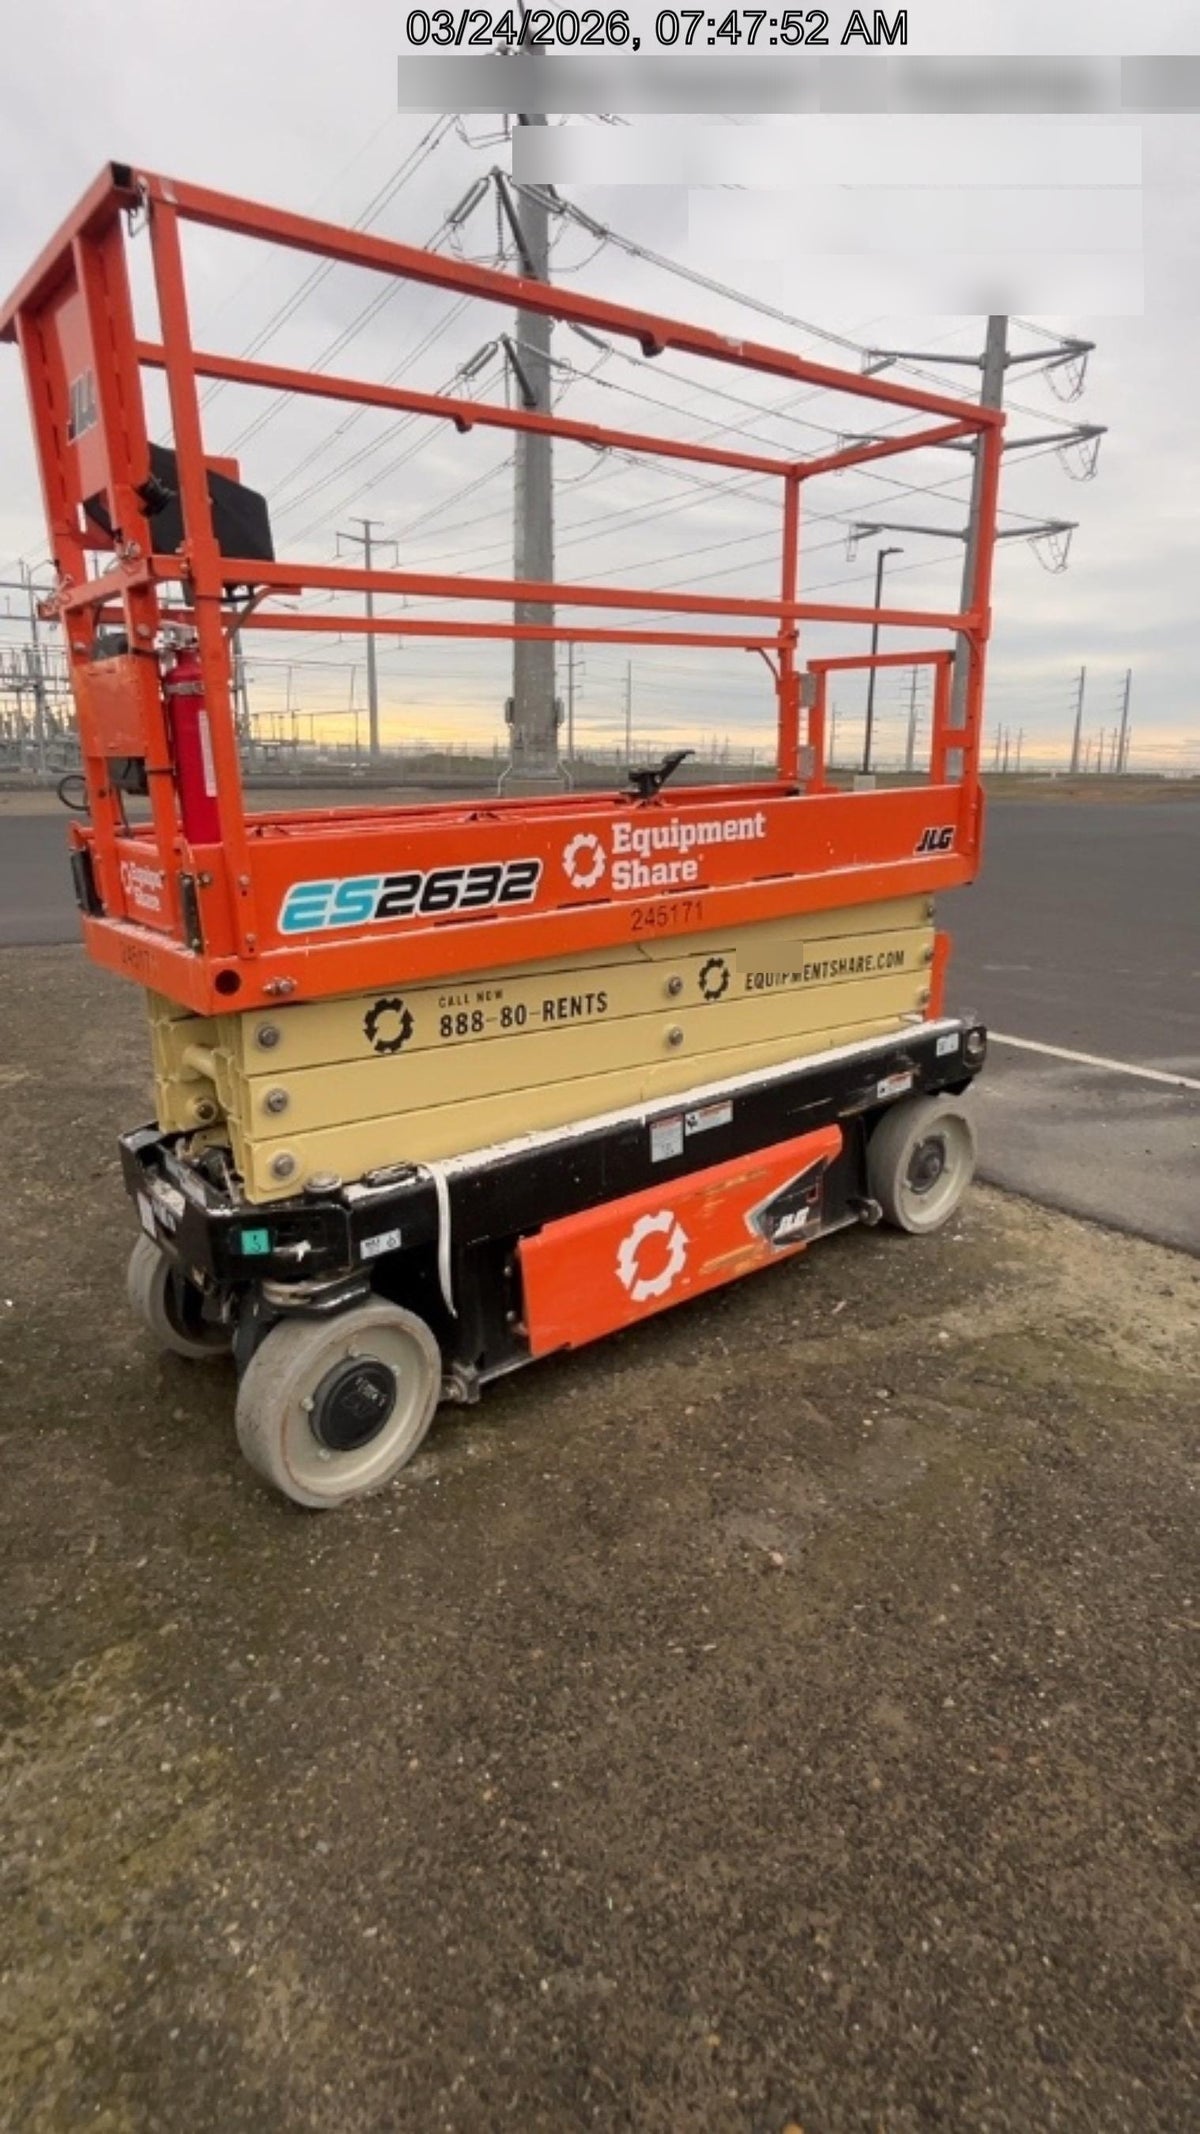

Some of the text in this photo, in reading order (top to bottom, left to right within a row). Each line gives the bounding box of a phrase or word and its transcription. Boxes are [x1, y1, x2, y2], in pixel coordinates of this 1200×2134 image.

[611, 811, 767, 859] Equipment
[914, 826, 956, 854] JLG
[611, 858, 699, 891] Share
[278, 858, 543, 935] ES2632
[630, 900, 704, 932] 245171
[438, 993, 471, 1008] CALL
[440, 991, 608, 1038] 888-80-RENTS
